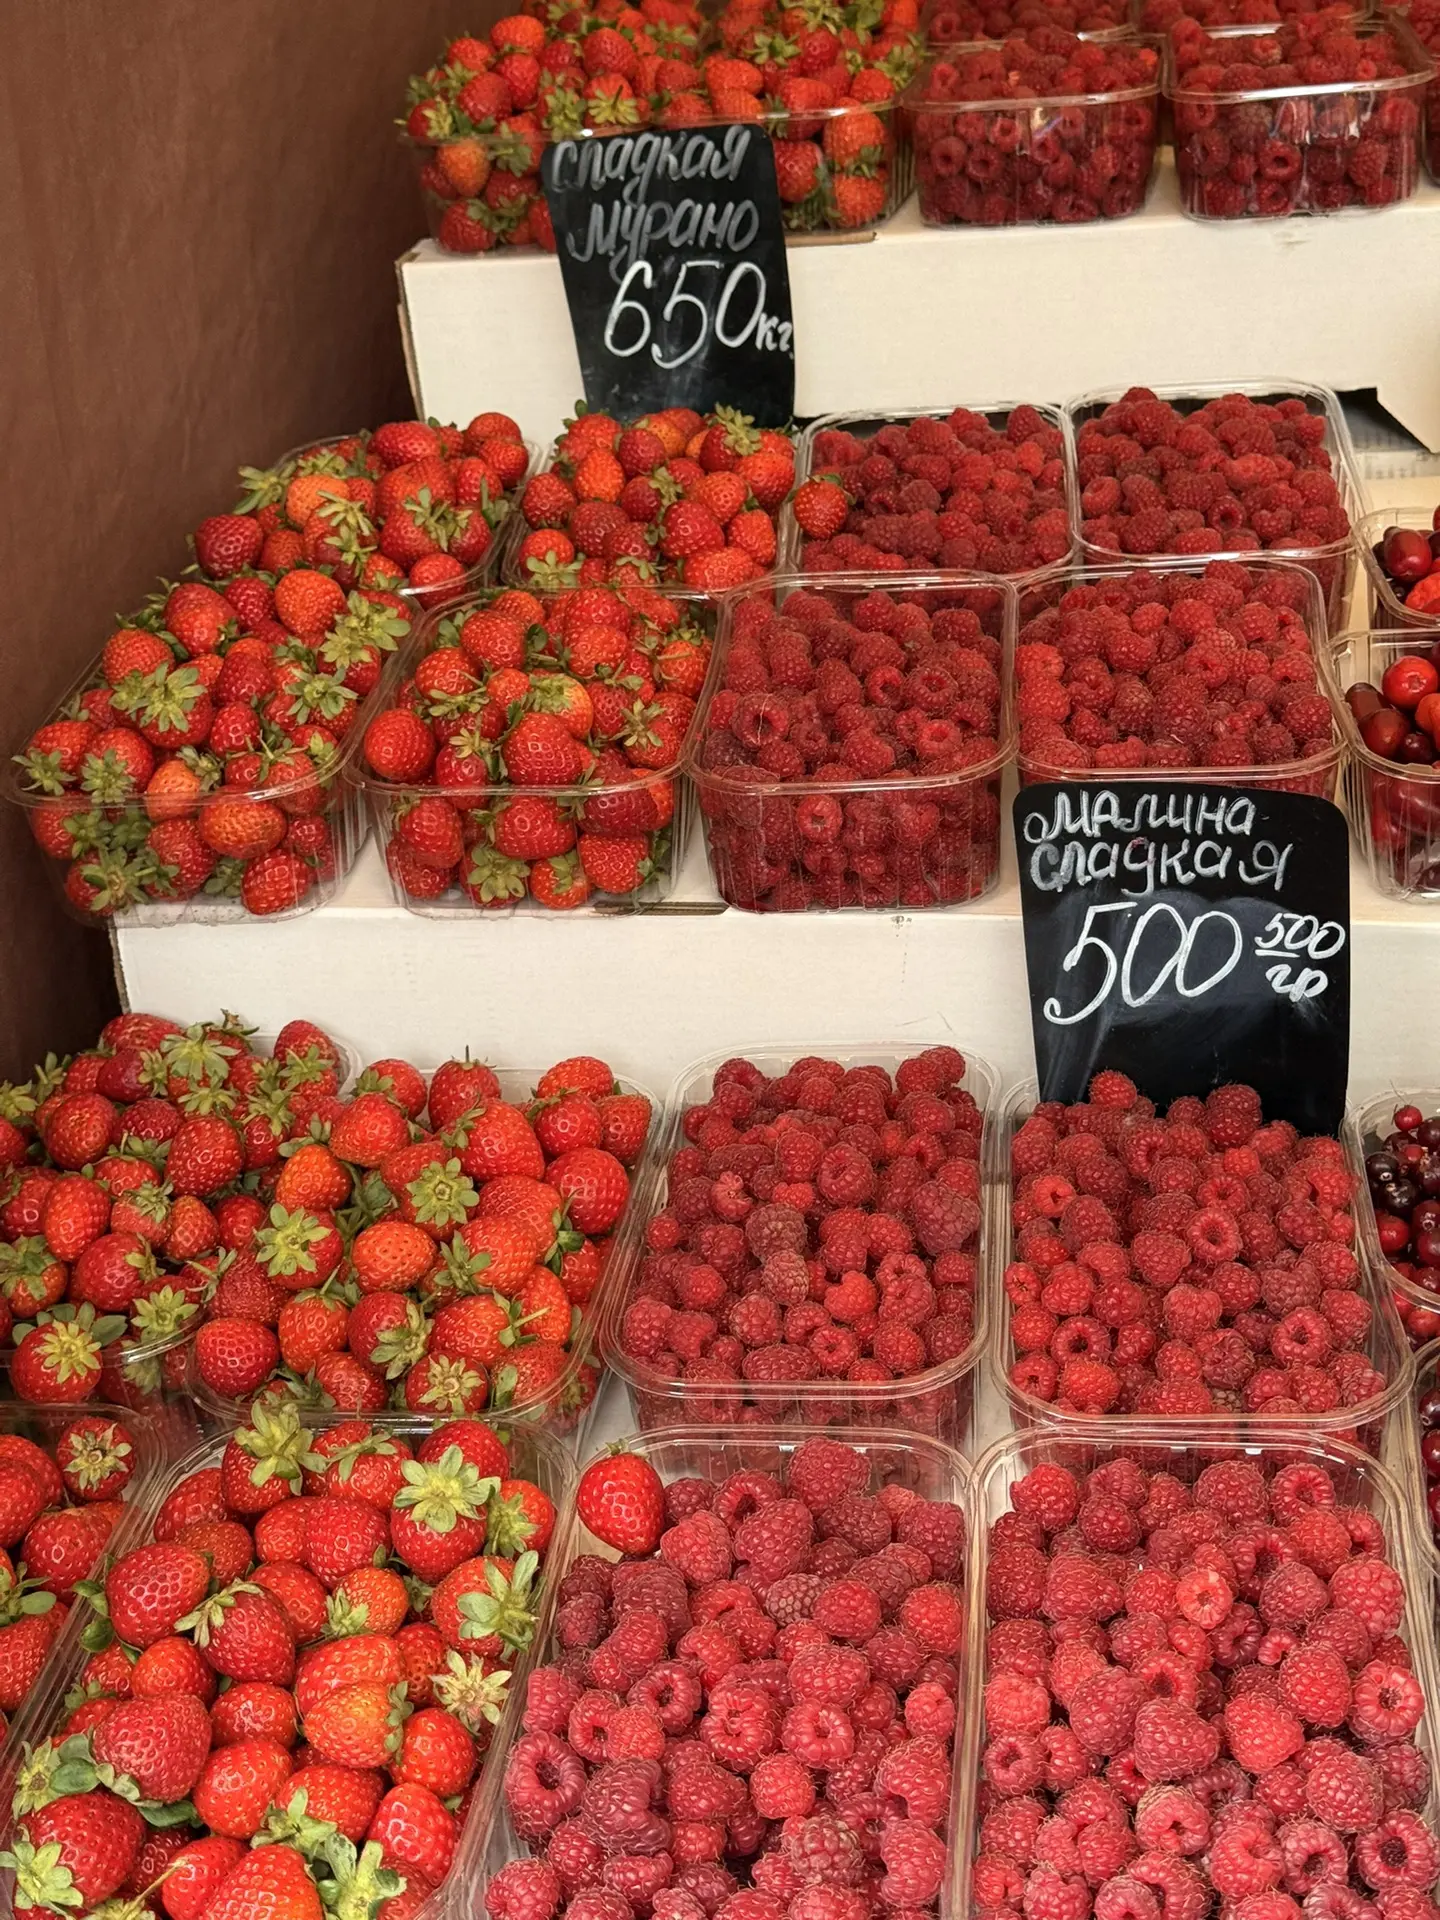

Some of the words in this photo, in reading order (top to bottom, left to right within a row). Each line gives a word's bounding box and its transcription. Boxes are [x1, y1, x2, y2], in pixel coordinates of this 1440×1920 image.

[604, 260, 766, 369] 650
[1043, 901, 1243, 1025] 500
[1254, 912, 1346, 960] 500
[1265, 963, 1329, 1002] гр
